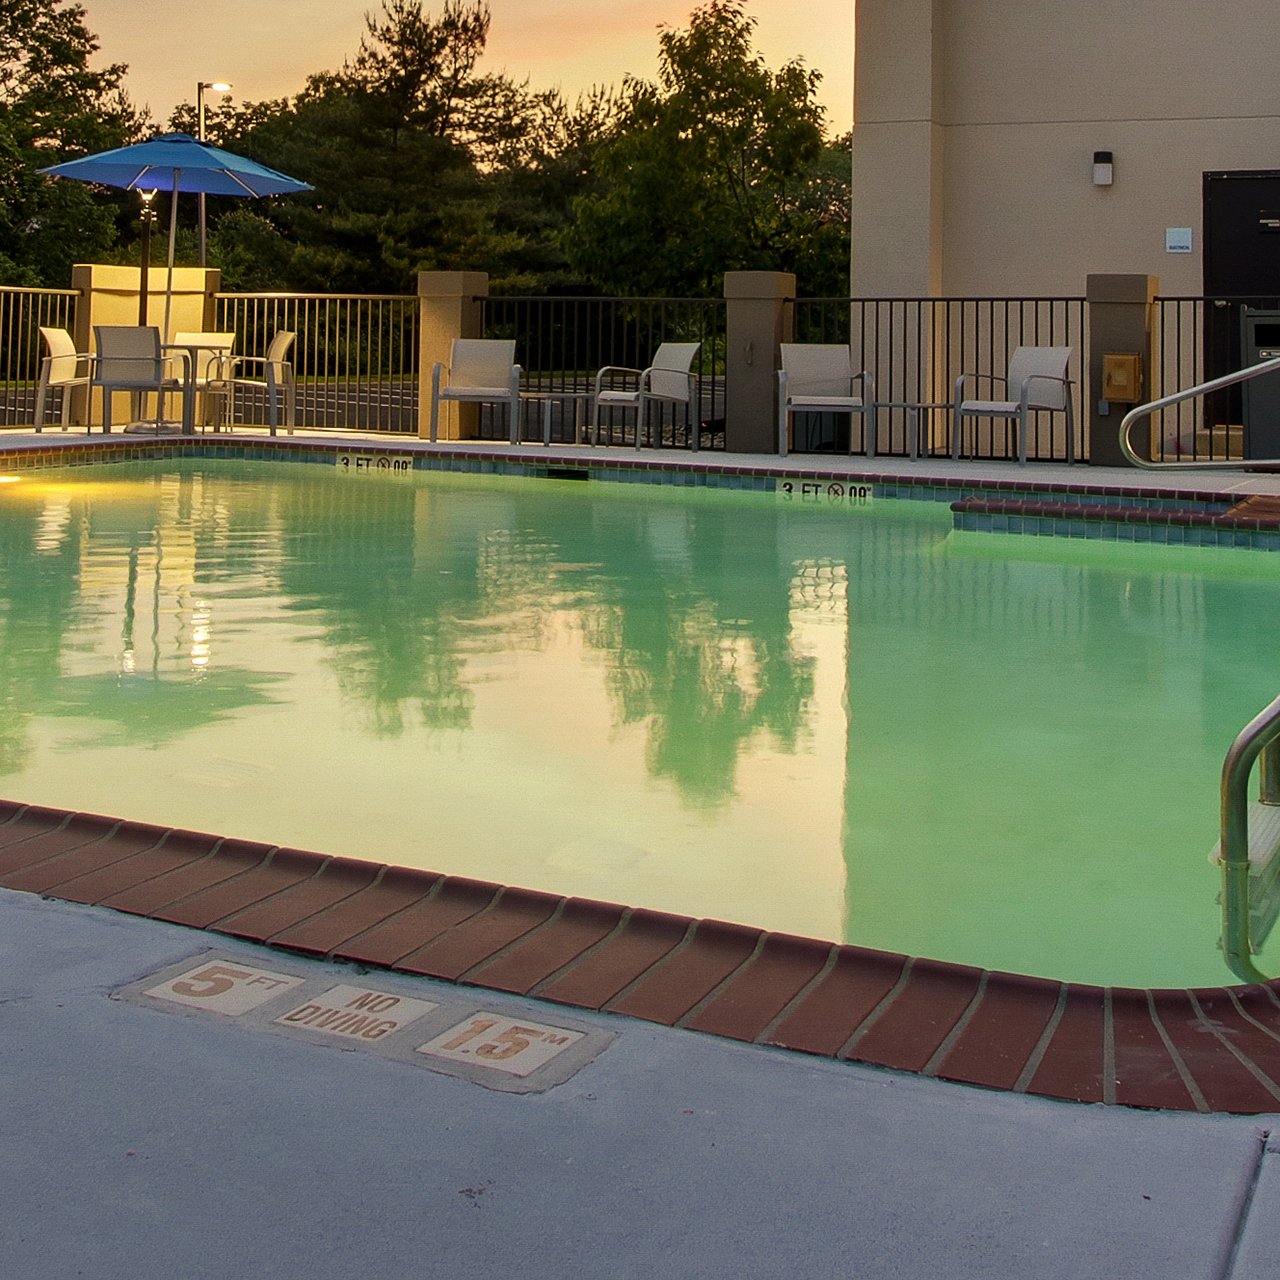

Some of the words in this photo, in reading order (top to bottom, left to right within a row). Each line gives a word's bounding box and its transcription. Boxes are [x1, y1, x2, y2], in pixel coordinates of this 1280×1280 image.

[248, 974, 291, 991] FT
[344, 991, 401, 1014] NO
[284, 1004, 398, 1040] DIVING
[440, 1018, 545, 1061] 1.5
